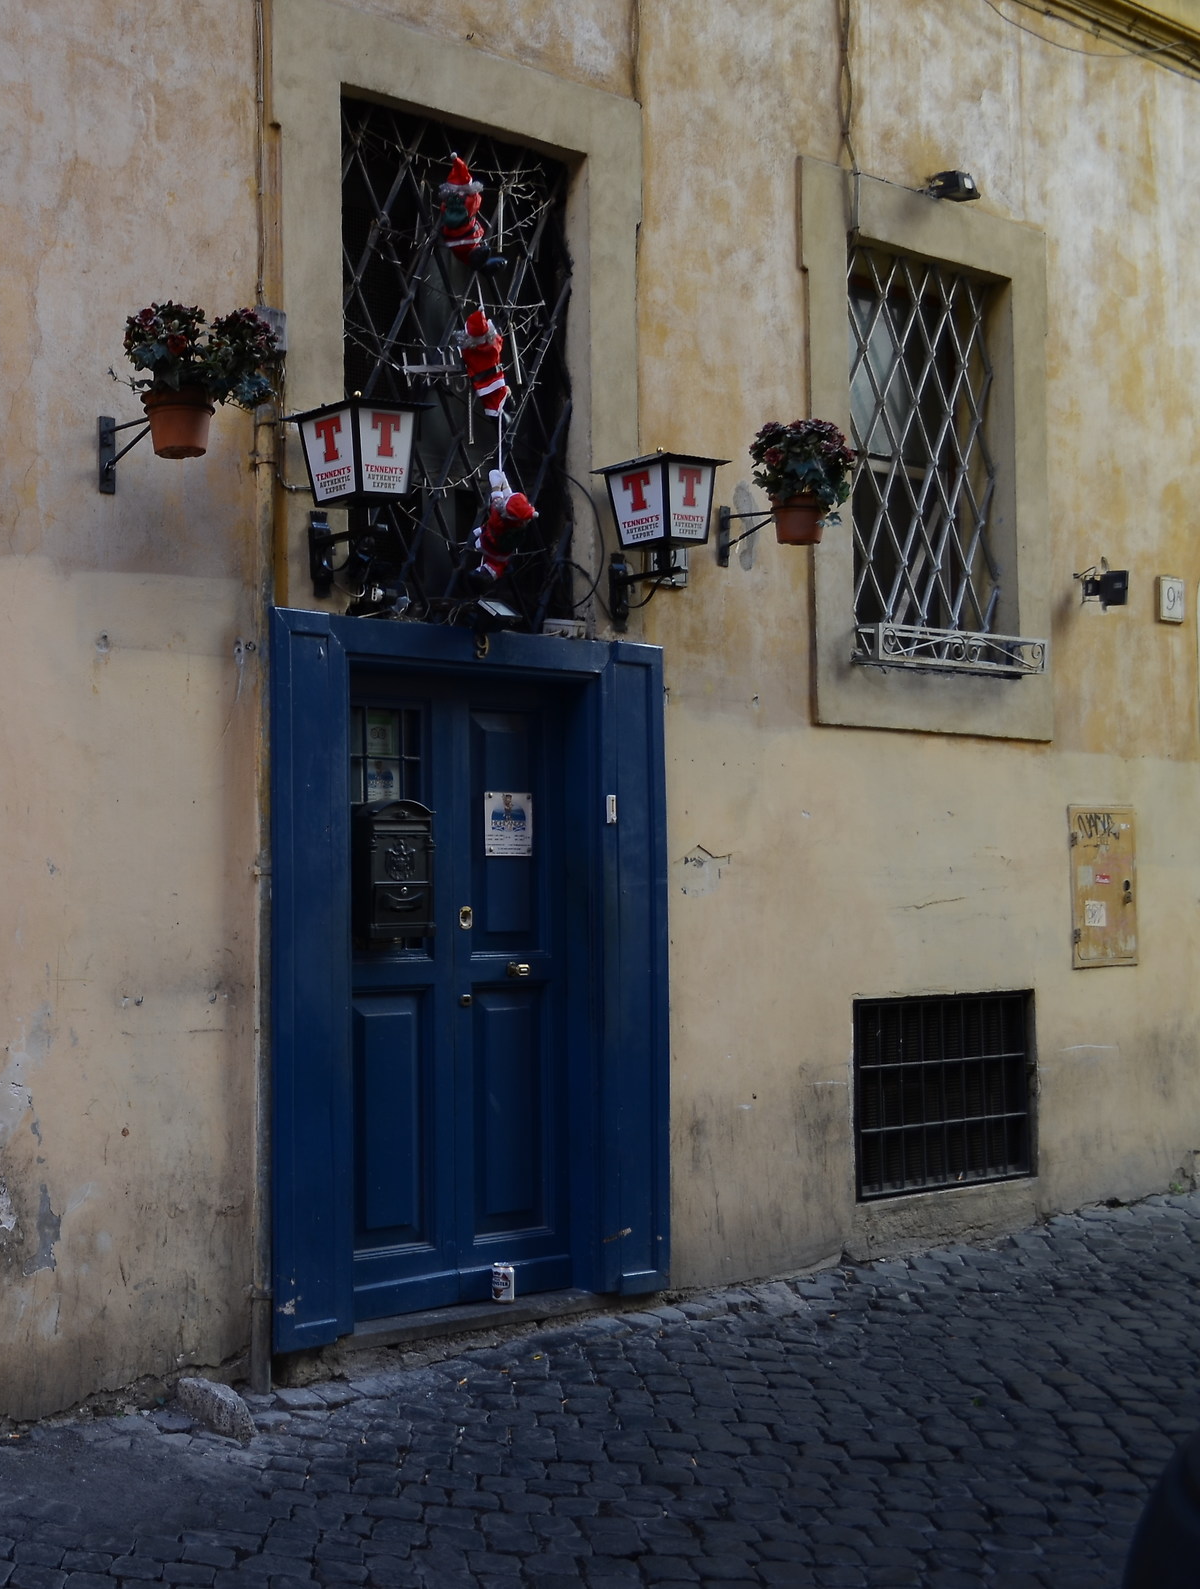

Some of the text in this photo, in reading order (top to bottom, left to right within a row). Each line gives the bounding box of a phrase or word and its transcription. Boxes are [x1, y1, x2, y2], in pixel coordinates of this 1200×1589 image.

[314, 415, 341, 463] T
[372, 411, 401, 458] T
[316, 466, 351, 482] TENNENT'S
[365, 463, 404, 475] TENNENT'S
[319, 475, 350, 489] AUTHENTIC
[367, 473, 401, 483] AUTHENTIC
[325, 484, 346, 494] EXPORT
[621, 469, 650, 513] T
[678, 467, 702, 507] T
[622, 514, 660, 529] TENNENT'S
[673, 513, 704, 523] TENNENT'S
[626, 522, 659, 535] AUTHENTIC
[674, 521, 702, 530] AUTHENTIC
[679, 528, 698, 536] EXPORT
[632, 530, 654, 540] EXPORT
